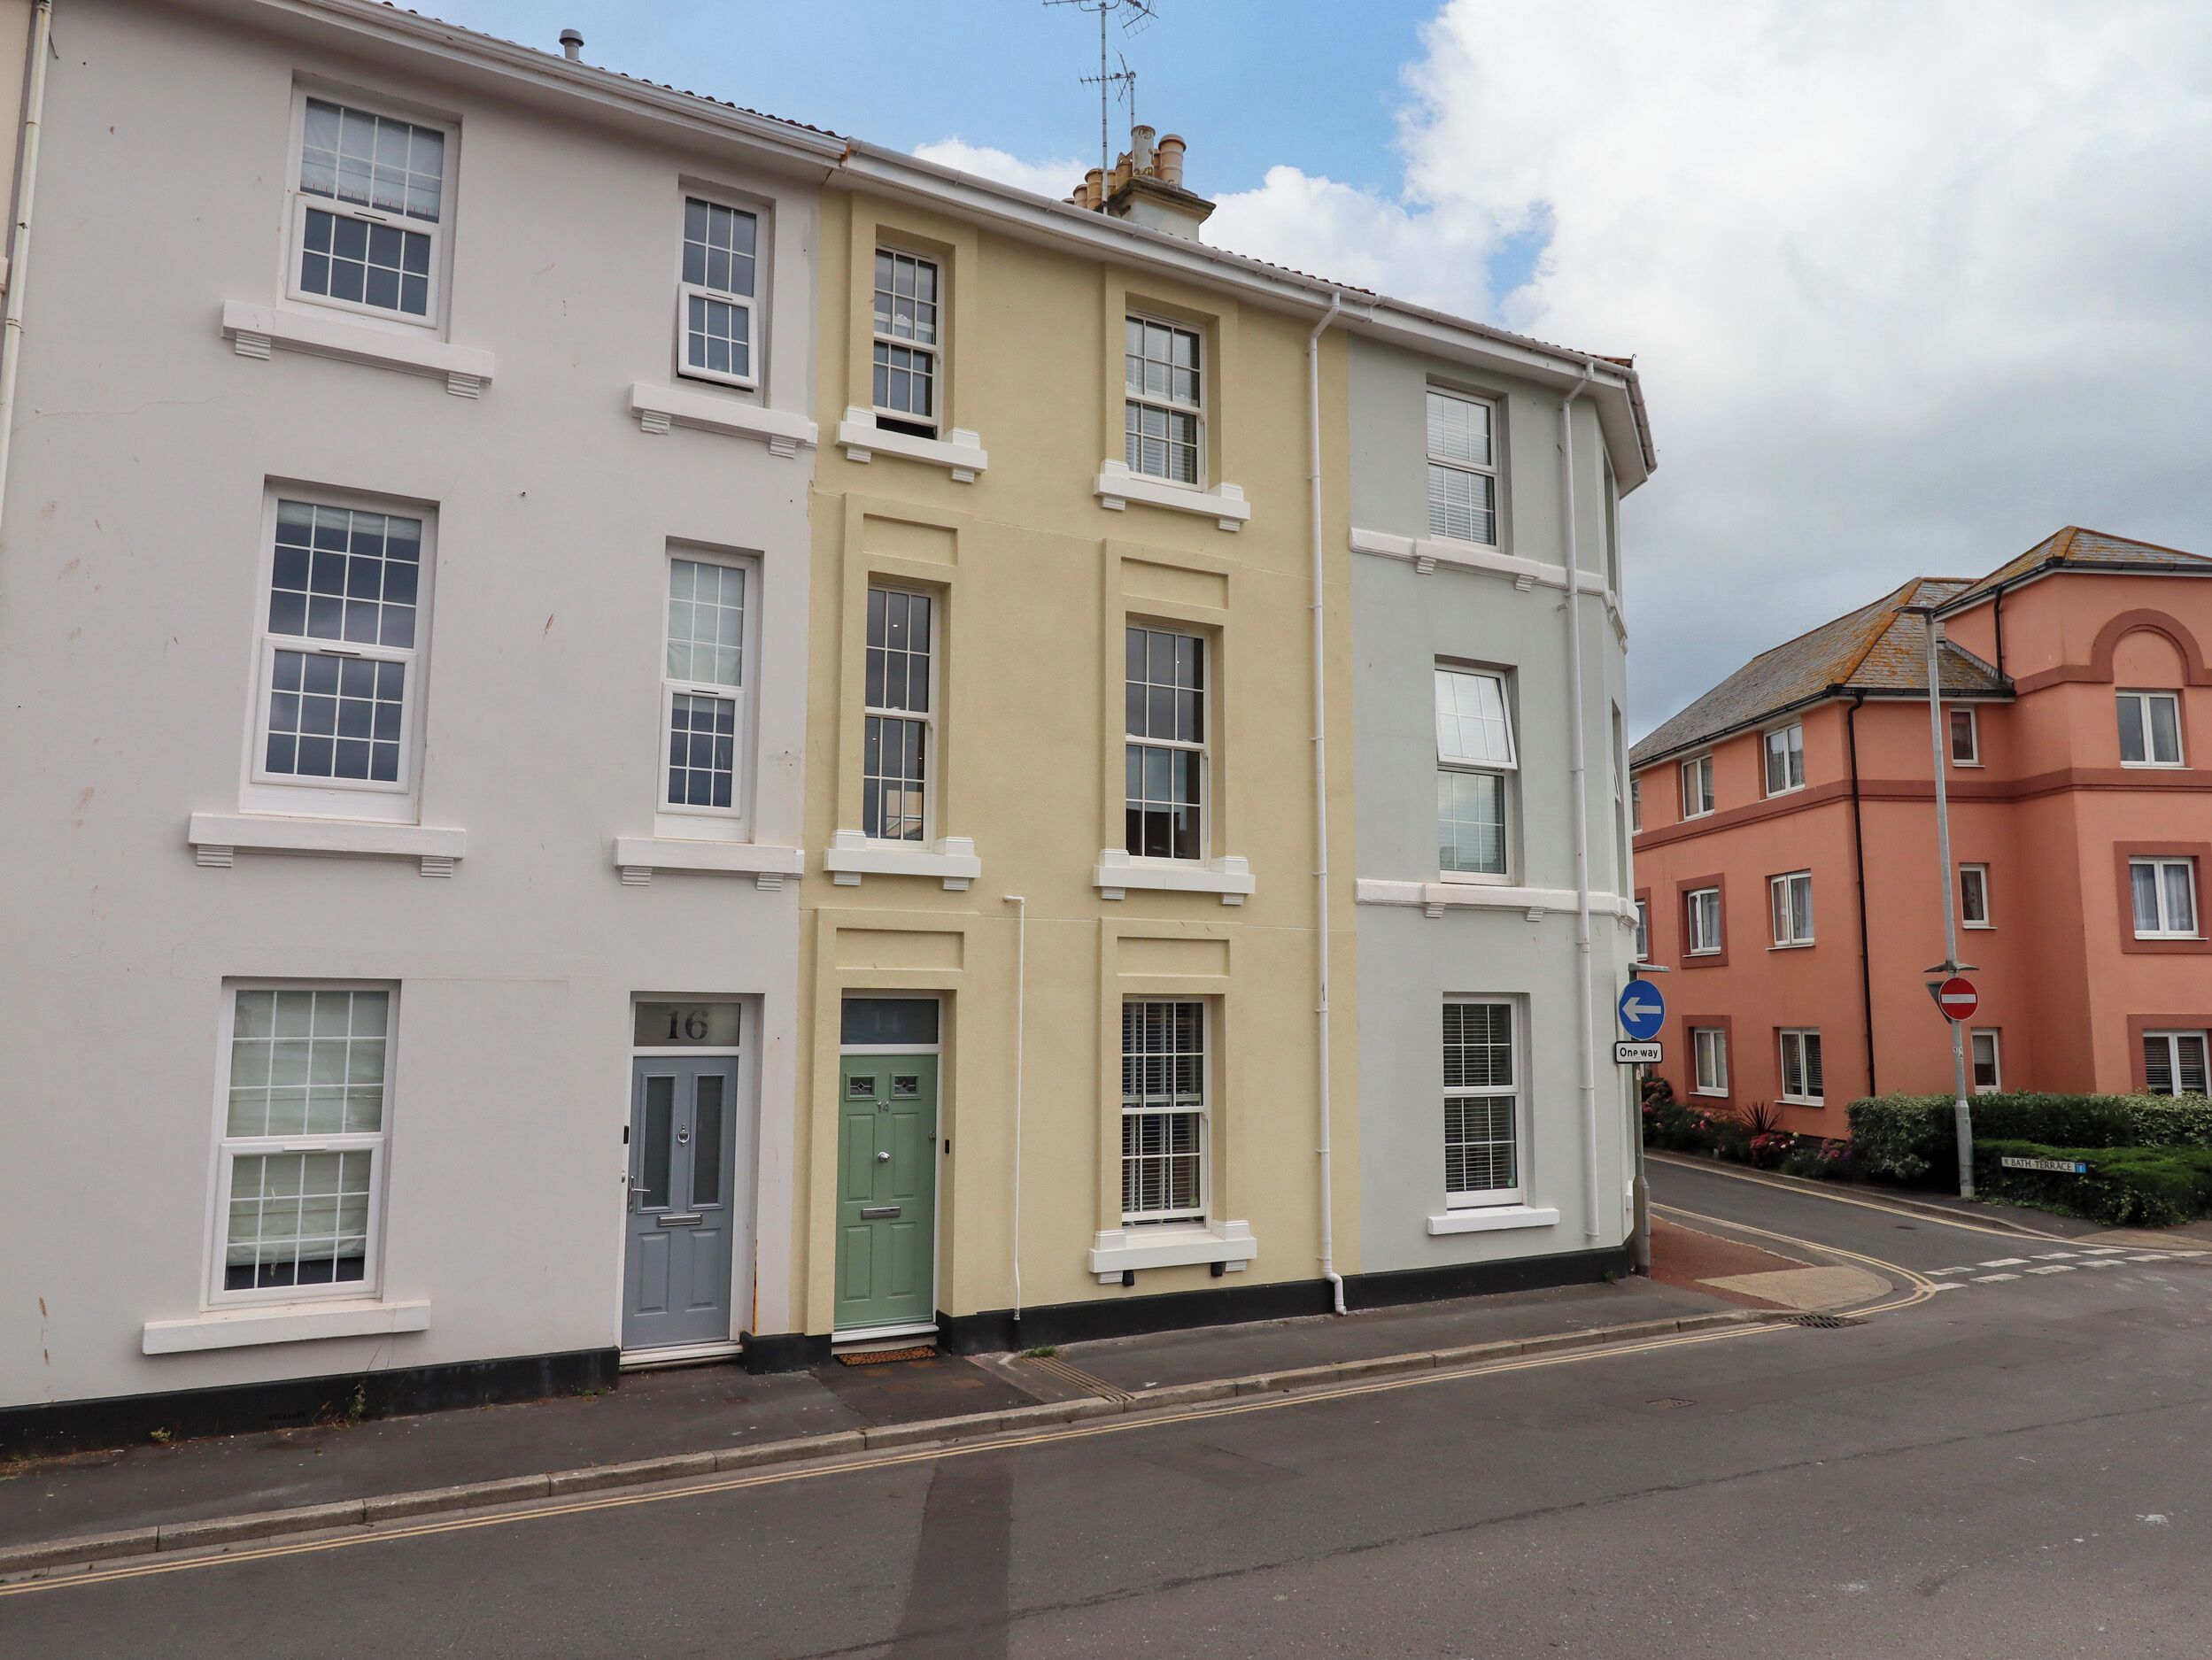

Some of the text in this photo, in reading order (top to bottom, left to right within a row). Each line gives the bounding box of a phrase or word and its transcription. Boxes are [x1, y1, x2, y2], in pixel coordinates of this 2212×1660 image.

[666, 1010, 708, 1040] 16
[1620, 1047, 1638, 1057] One
[1640, 1049, 1658, 1059] way
[2011, 1158, 2073, 1171] BATH TERRACE
